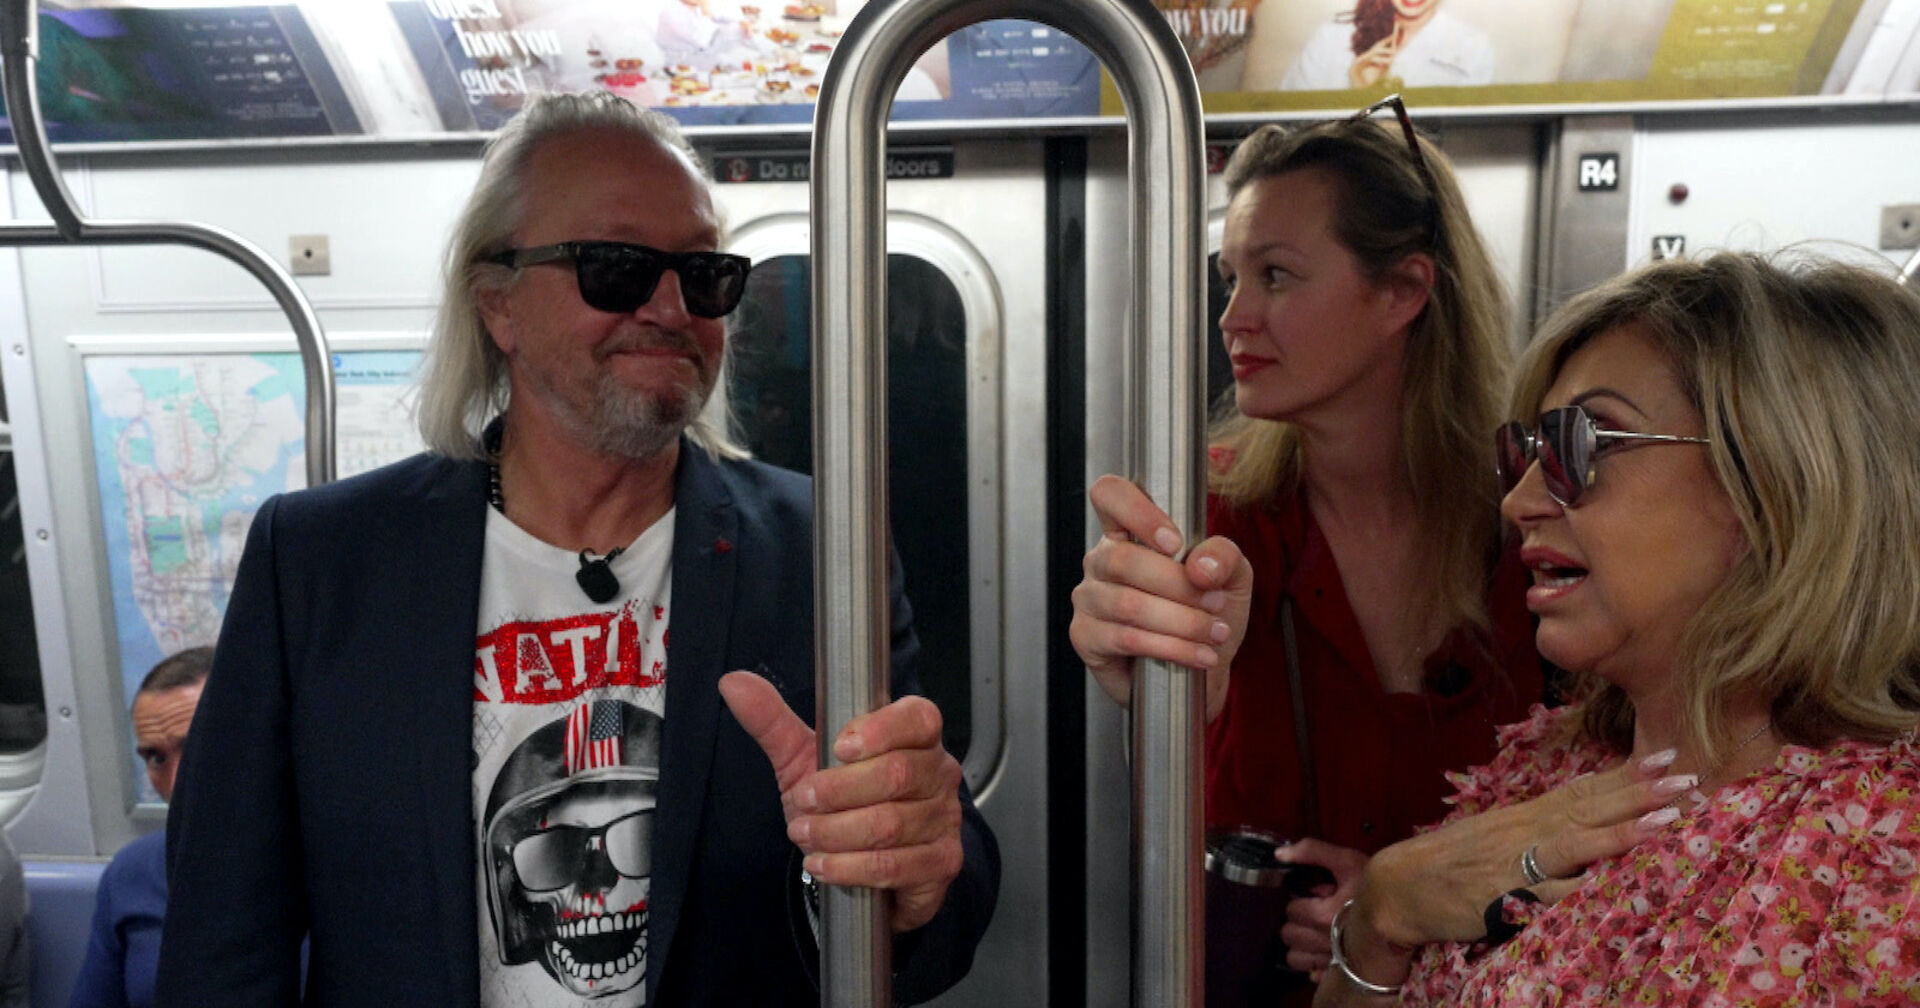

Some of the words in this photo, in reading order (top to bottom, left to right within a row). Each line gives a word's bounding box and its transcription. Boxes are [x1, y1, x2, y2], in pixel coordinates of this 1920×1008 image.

[451, 20, 513, 58] how
[510, 30, 562, 67] you
[1199, 8, 1247, 48] you
[460, 66, 529, 105] guest
[760, 160, 787, 179] Do
[1580, 159, 1616, 187] R4
